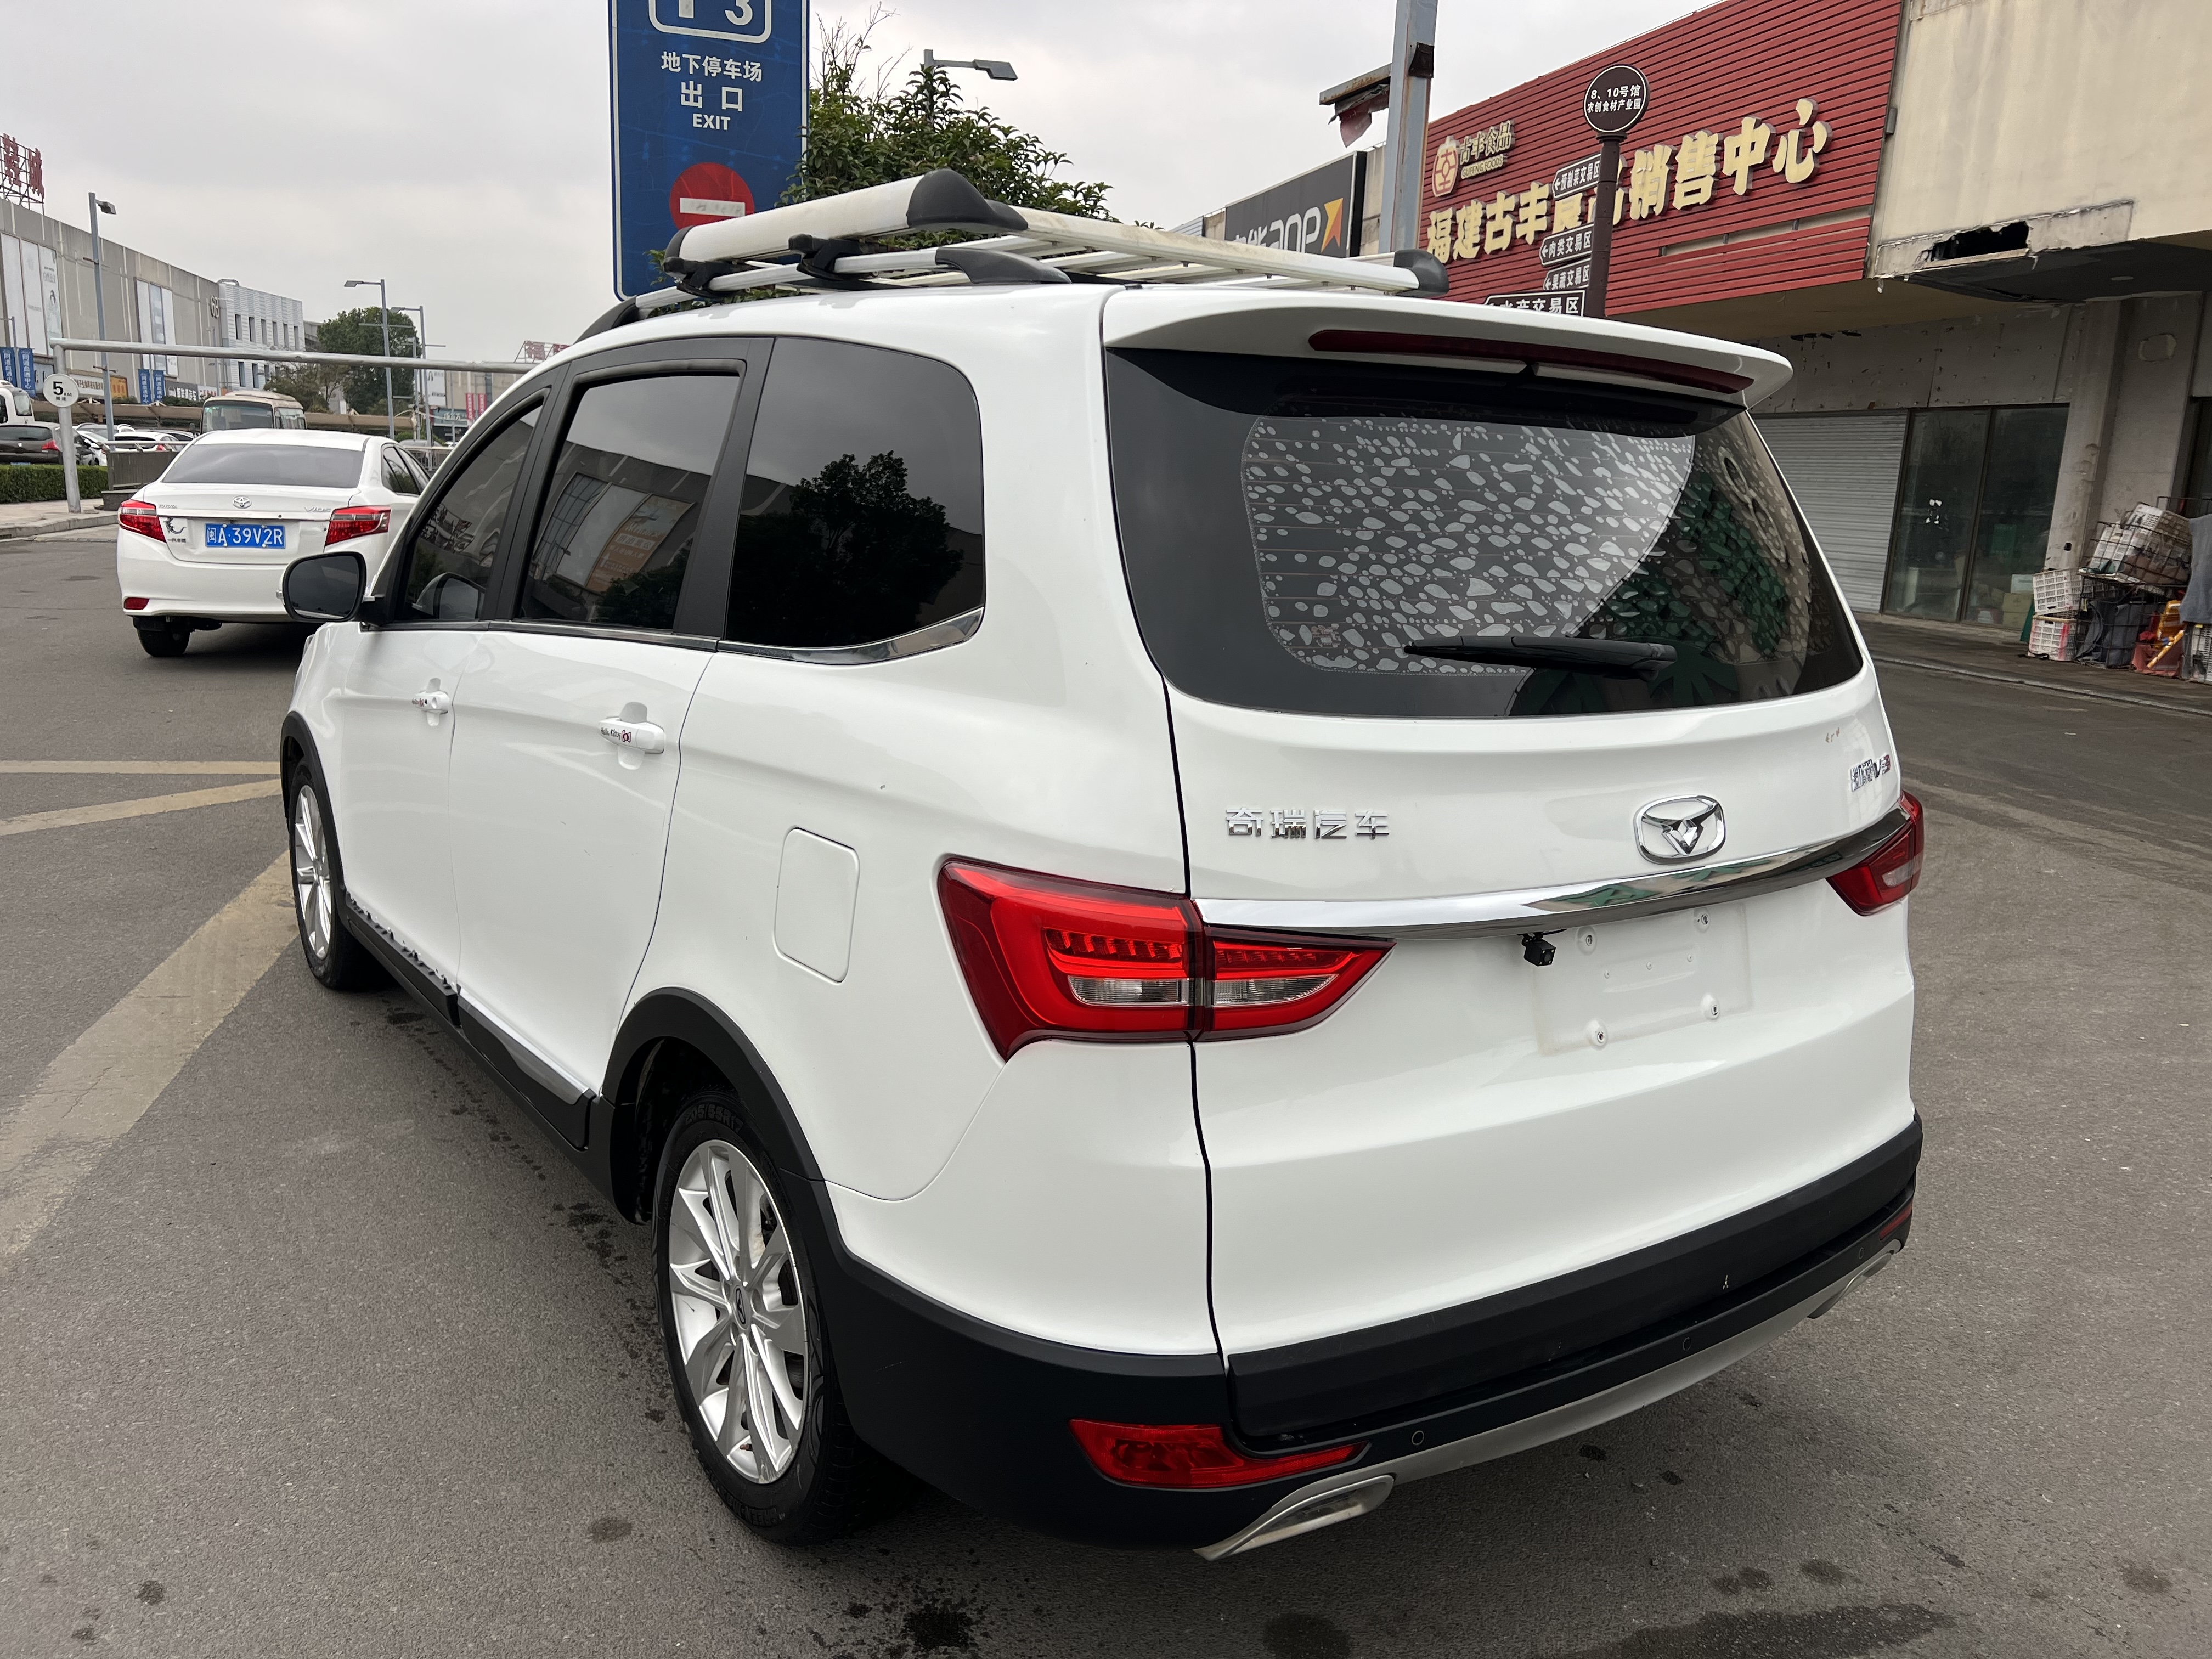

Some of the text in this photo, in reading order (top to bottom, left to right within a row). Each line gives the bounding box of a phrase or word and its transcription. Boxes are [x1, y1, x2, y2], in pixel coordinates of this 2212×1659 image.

[661, 51, 762, 82] 地下停车场
[681, 81, 743, 112] 出口
[1587, 98, 1641, 114] 农创食材产业园
[1591, 84, 1641, 100] 8、10号馆
[692, 113, 731, 131] EXIT
[1460, 121, 1512, 165] 古丰食品
[1462, 156, 1503, 177] GUFENG FOODS
[1560, 160, 1600, 191] 预制菜交易区
[1548, 230, 1592, 258] 肉类交易区
[1551, 264, 1590, 290] 果蔬交易区
[53, 381, 64, 396] 5
[1226, 807, 1390, 840] 奇瑞汽车
[685, 1103, 744, 1133] 205/55R17
